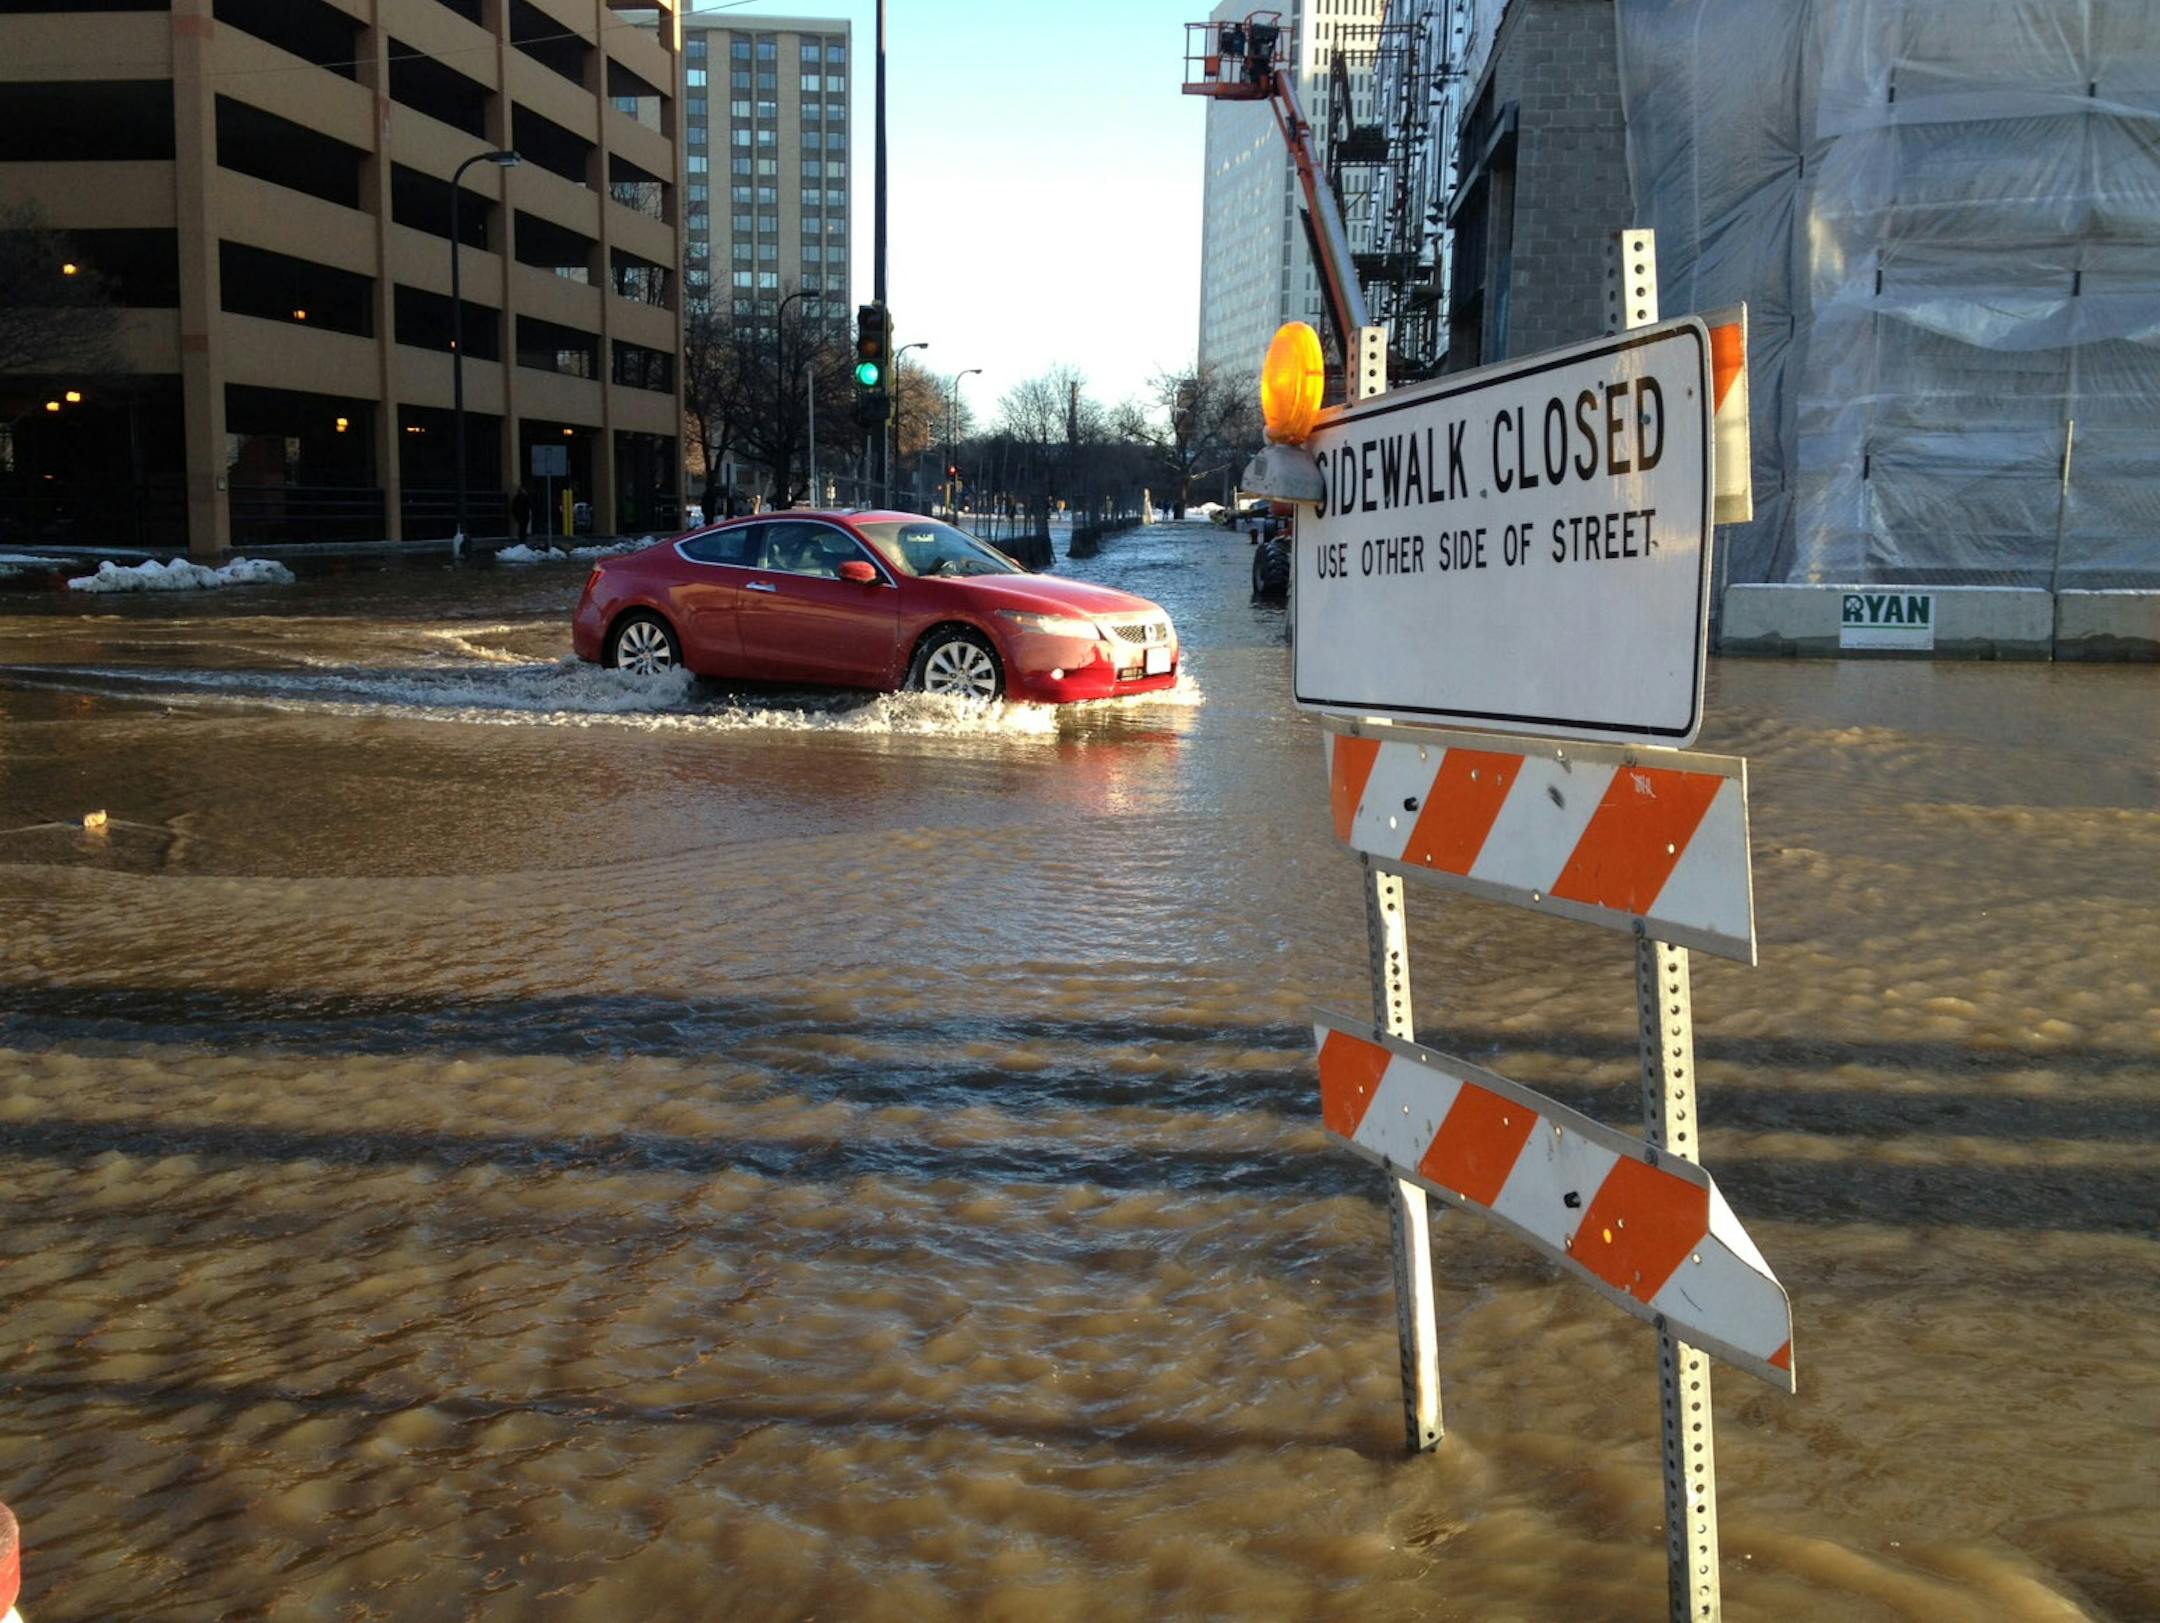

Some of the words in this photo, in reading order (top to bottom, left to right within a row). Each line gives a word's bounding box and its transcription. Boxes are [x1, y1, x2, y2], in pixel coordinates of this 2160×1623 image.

[1314, 420, 1468, 519] SIDEWALK
[1493, 376, 1664, 493] CLOSED
[1317, 543, 1348, 579] USE
[1361, 535, 1424, 577] OTHER
[1439, 528, 1487, 571] SIDE
[1504, 522, 1534, 566] OF
[1552, 508, 1656, 563] STREET
[1842, 595, 1930, 623] RYAN
